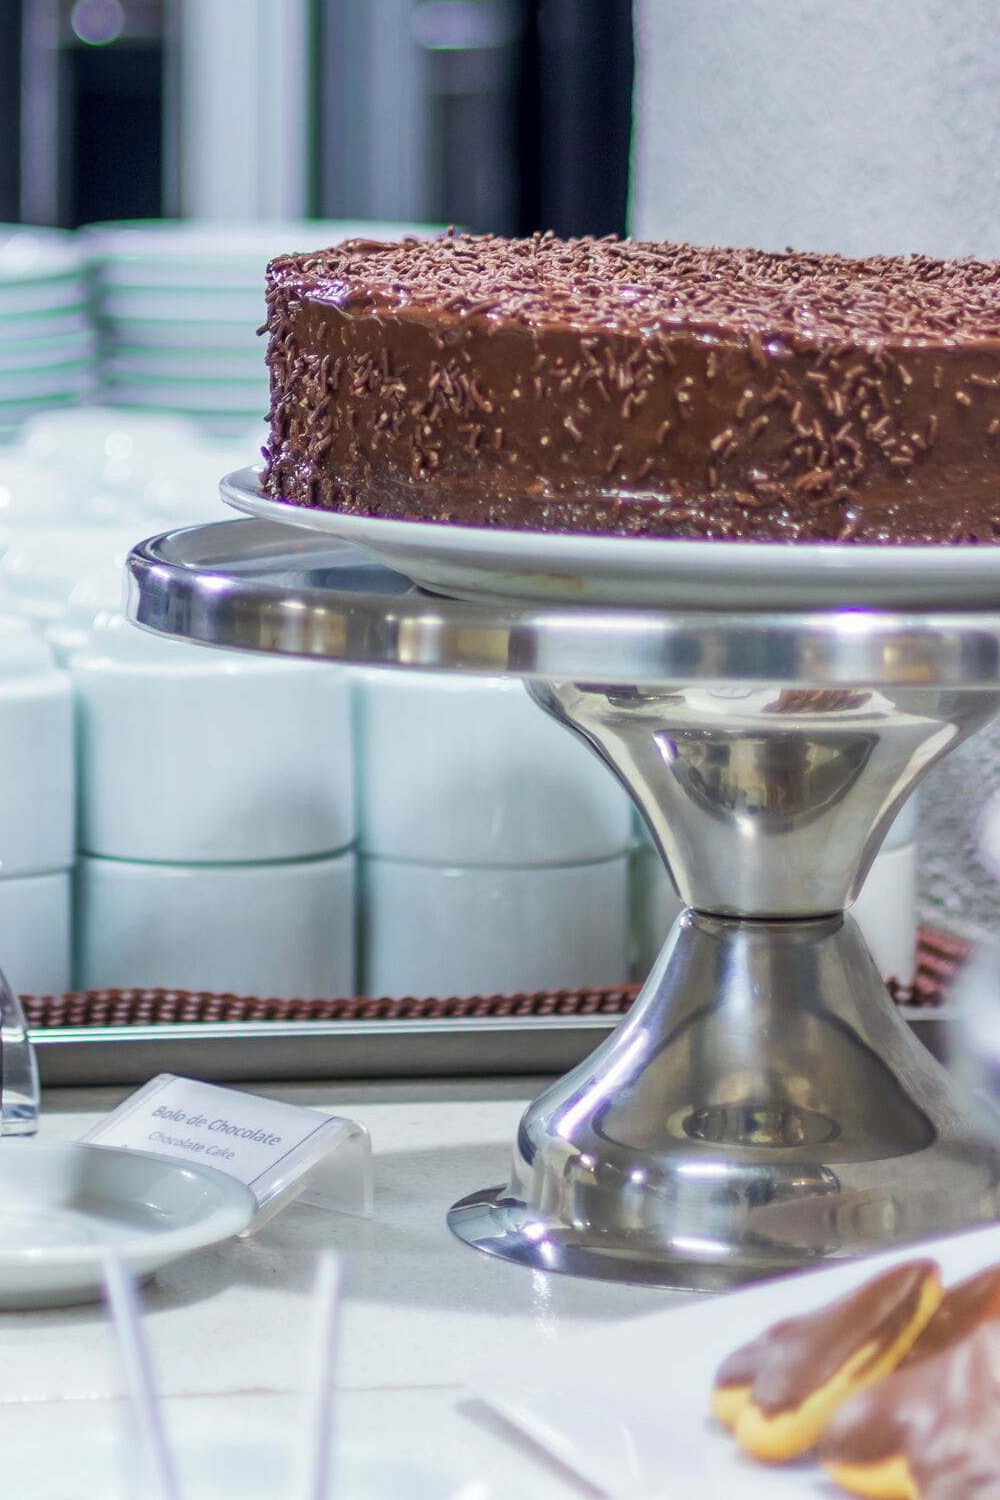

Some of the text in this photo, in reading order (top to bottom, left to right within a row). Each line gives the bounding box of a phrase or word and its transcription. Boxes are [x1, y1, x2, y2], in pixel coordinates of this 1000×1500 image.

[151, 1105, 282, 1146] Bolo de Chocolate
[148, 1131, 235, 1160] Chocolate Cake
